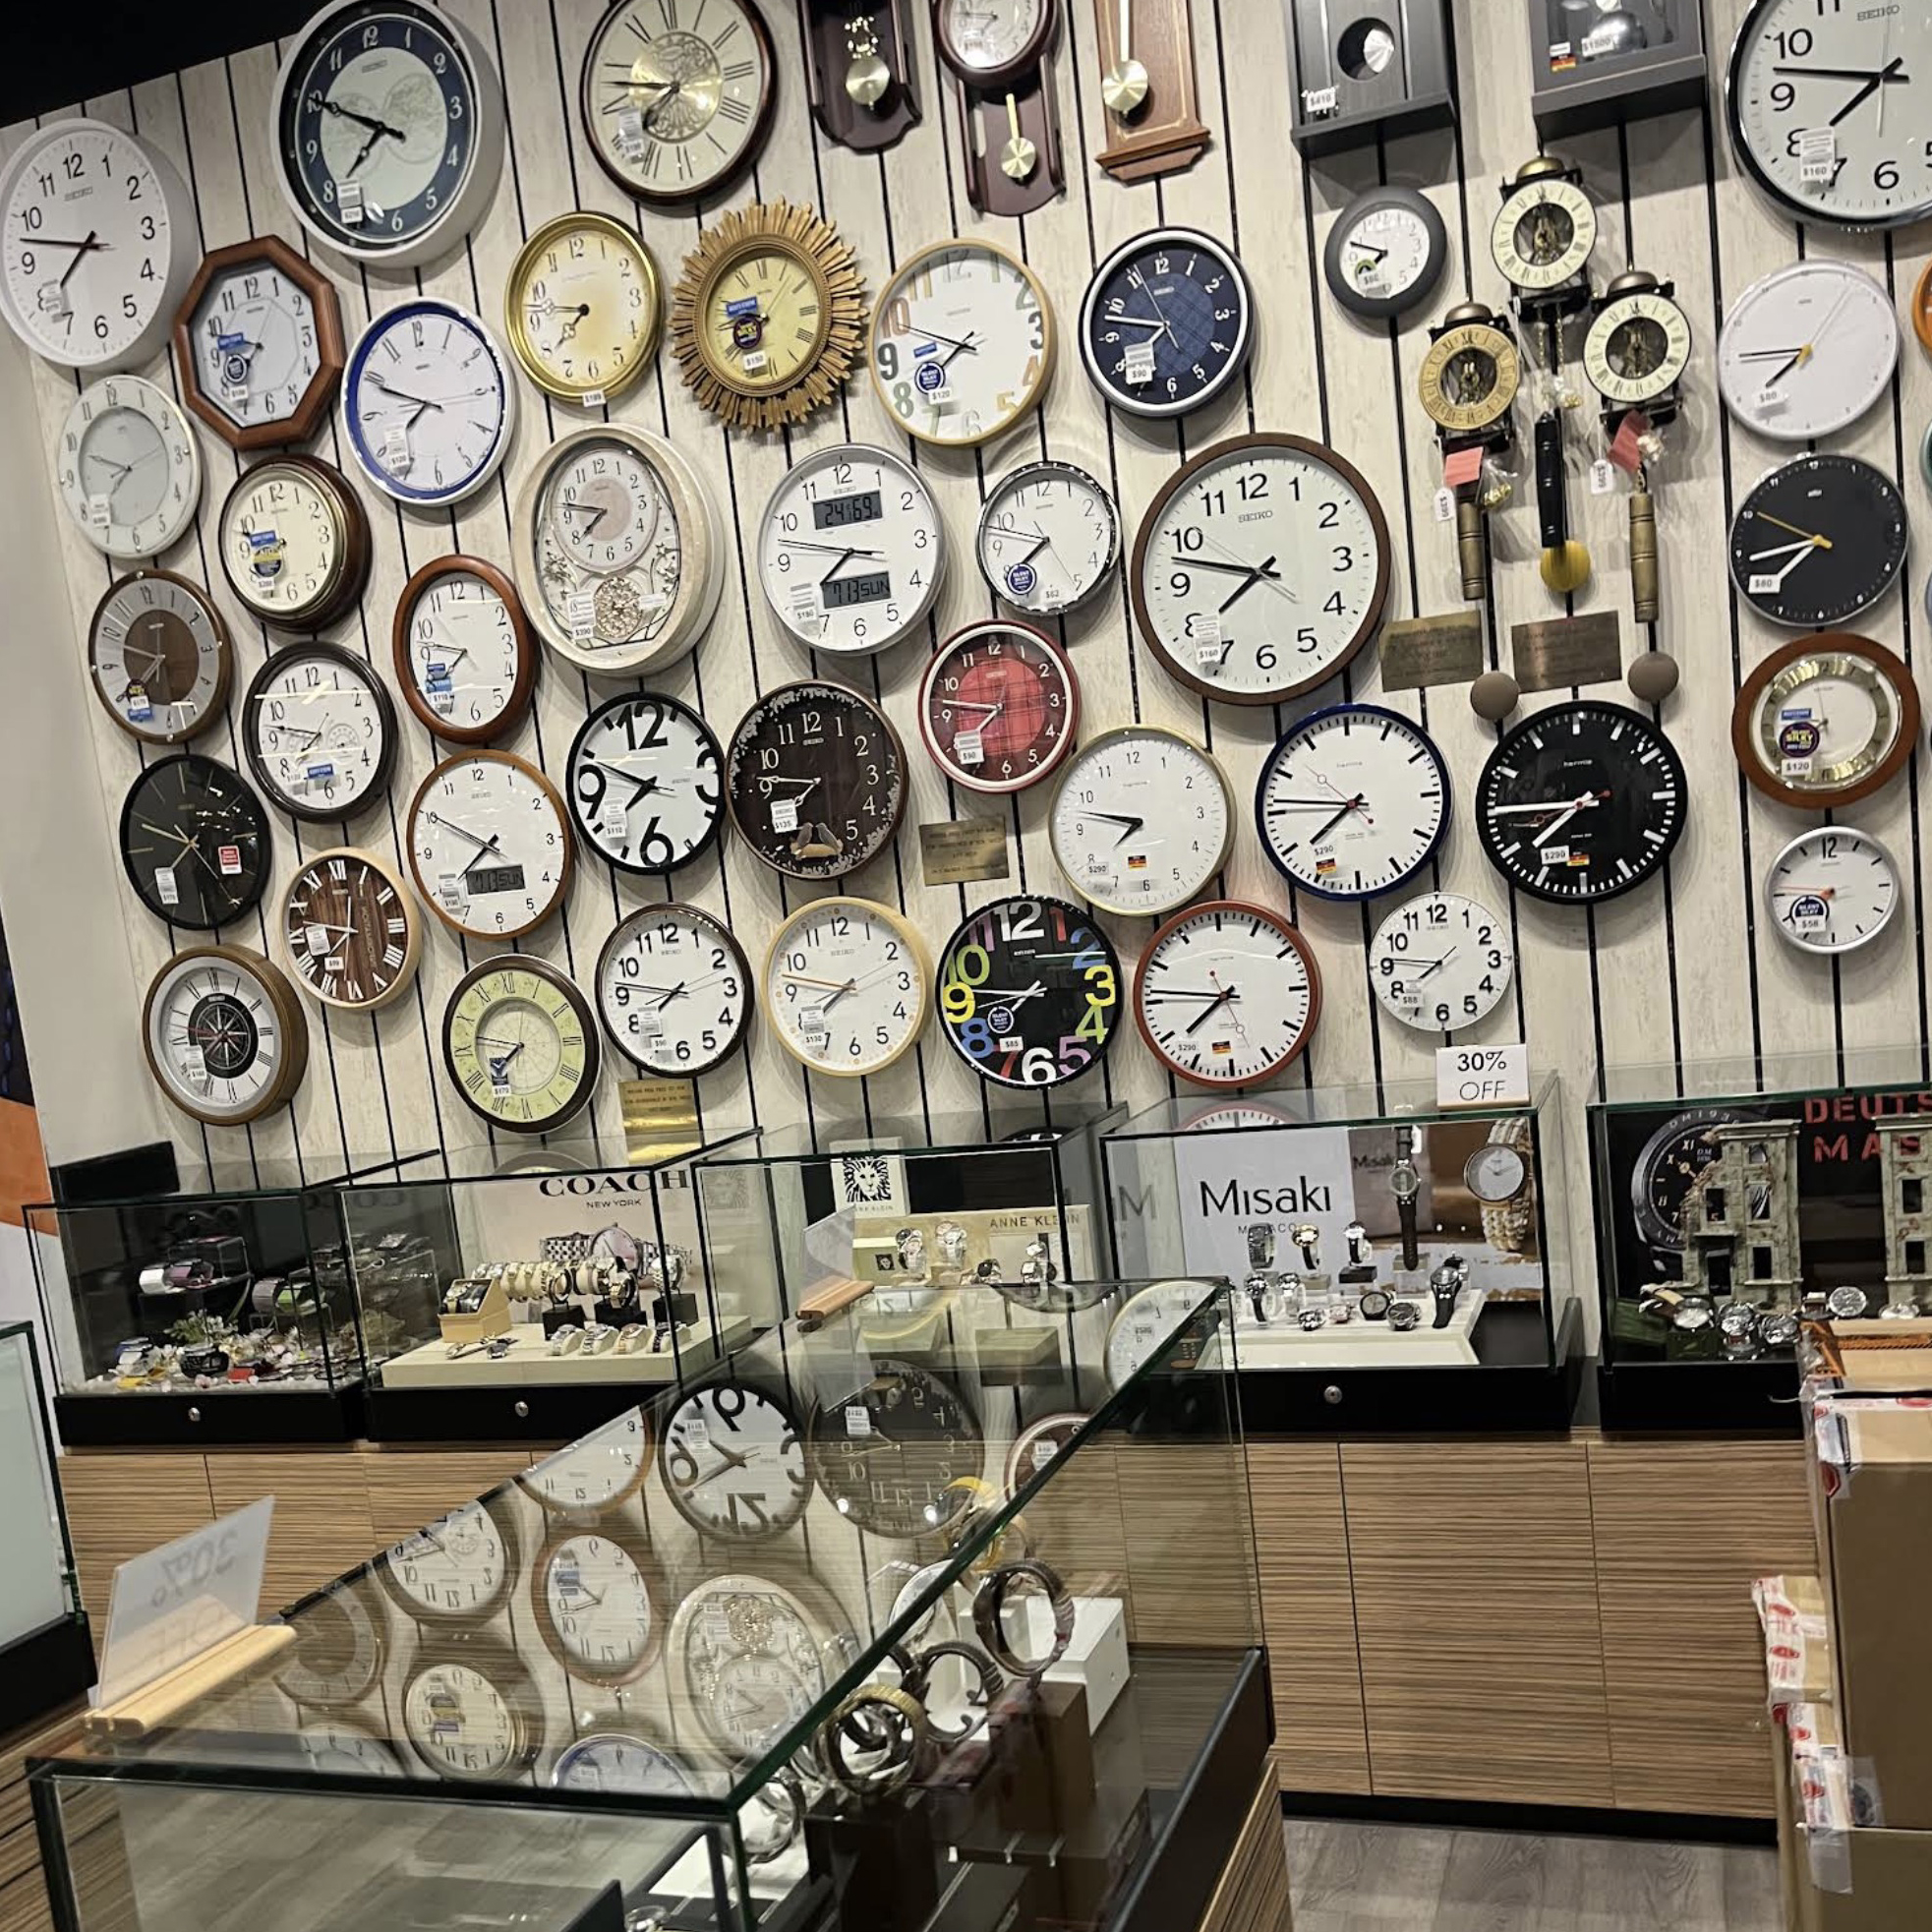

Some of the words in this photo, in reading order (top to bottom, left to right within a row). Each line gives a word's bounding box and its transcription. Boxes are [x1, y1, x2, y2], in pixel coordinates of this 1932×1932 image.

[1857, 5, 1900, 21] SEIKO
[362, 26, 379, 48] 12
[1774, 29, 1813, 59] 10
[434, 53, 446, 74] 2
[1771, 83, 1794, 111] 9
[449, 96, 462, 119] 3
[307, 140, 317, 162] 9
[63, 153, 85, 179] 12
[1874, 160, 1899, 190] 6
[127, 176, 141, 200] 2
[22, 207, 41, 231] 10
[142, 216, 154, 240] 3
[22, 252, 35, 274] 9
[1154, 258, 1169, 274] 12
[1204, 278, 1219, 293] 2
[1109, 298, 1125, 315] 10
[94, 316, 108, 338] 6
[1028, 312, 1043, 349] 3
[878, 342, 899, 381] 9
[1167, 378, 1176, 392] 6
[894, 381, 913, 418] 8
[593, 459, 605, 474] 12
[834, 464, 852, 484] 12
[564, 488, 576, 502] 10
[1236, 473, 1268, 500] 12
[902, 492, 913, 510] 2
[1201, 490, 1225, 516] 11
[781, 513, 797, 531] 10
[1238, 510, 1273, 522] SEIKO
[1318, 502, 1338, 529] 2
[572, 531, 580, 545] 8
[914, 529, 926, 549] 3
[1172, 527, 1203, 553] 10
[778, 554, 790, 572] 9
[1332, 547, 1353, 571] 3
[450, 581, 464, 600] 12
[1171, 572, 1191, 597] 9
[887, 604, 899, 621] 5
[1323, 591, 1346, 615] 4
[419, 619, 433, 639] 10
[854, 618, 866, 636] 6
[988, 644, 1001, 655] 12
[1297, 627, 1317, 652] 5
[1257, 644, 1276, 670] 6
[306, 667, 321, 687] 12
[1039, 664, 1049, 677] 2
[944, 677, 959, 691] 10
[1050, 693, 1060, 707] 3
[270, 701, 284, 721] 10
[615, 701, 669, 750] 12
[802, 712, 821, 733] 12
[854, 735, 868, 756] 2
[760, 748, 779, 769] 10
[1002, 761, 1012, 773] 6
[1127, 751, 1141, 764] 12
[866, 765, 879, 786] 3
[1186, 777, 1193, 790] 2
[579, 765, 607, 819] 9
[1081, 790, 1093, 803] 10
[862, 794, 876, 816] 4
[547, 834, 555, 845] 3
[846, 819, 858, 840] 5
[640, 816, 674, 867] 6
[1822, 838, 1837, 859] 12
[424, 848, 432, 859] 9
[994, 901, 1045, 942] 12
[1427, 904, 1447, 923] 12
[657, 923, 678, 944] 12
[832, 916, 849, 936] 12
[1478, 926, 1492, 945] 2
[886, 942, 898, 961] 2
[1387, 933, 1408, 952] 10
[618, 958, 638, 977] 10
[712, 949, 726, 969] 2
[788, 953, 805, 971] 10
[947, 945, 990, 985] 10
[1380, 958, 1394, 975] 9
[1488, 950, 1501, 968] 3
[724, 977, 736, 997] 3
[898, 971, 909, 990] 3
[1084, 965, 1116, 1007] 3
[1479, 974, 1493, 994] 4
[615, 986, 629, 1006] 9
[786, 984, 796, 1002] 9
[943, 981, 975, 1024] 9
[893, 1002, 907, 1020] 4
[1436, 1004, 1449, 1022] 6
[1464, 995, 1477, 1014] 5
[719, 1007, 732, 1026] 4
[1076, 1005, 1108, 1044] 4
[877, 1026, 889, 1044] 5
[961, 1018, 994, 1058] 8
[676, 1041, 690, 1060] 6
[849, 1037, 861, 1055] 6
[1059, 1035, 1090, 1075] 5
[1022, 1047, 1056, 1083] 6
[1457, 1051, 1506, 1072] 30%
[1460, 1081, 1505, 1101] OFF
[540, 1170, 689, 1198] COACH
[1200, 1176, 1331, 1217] Misaki
[990, 1217, 1027, 1227] ANNE
